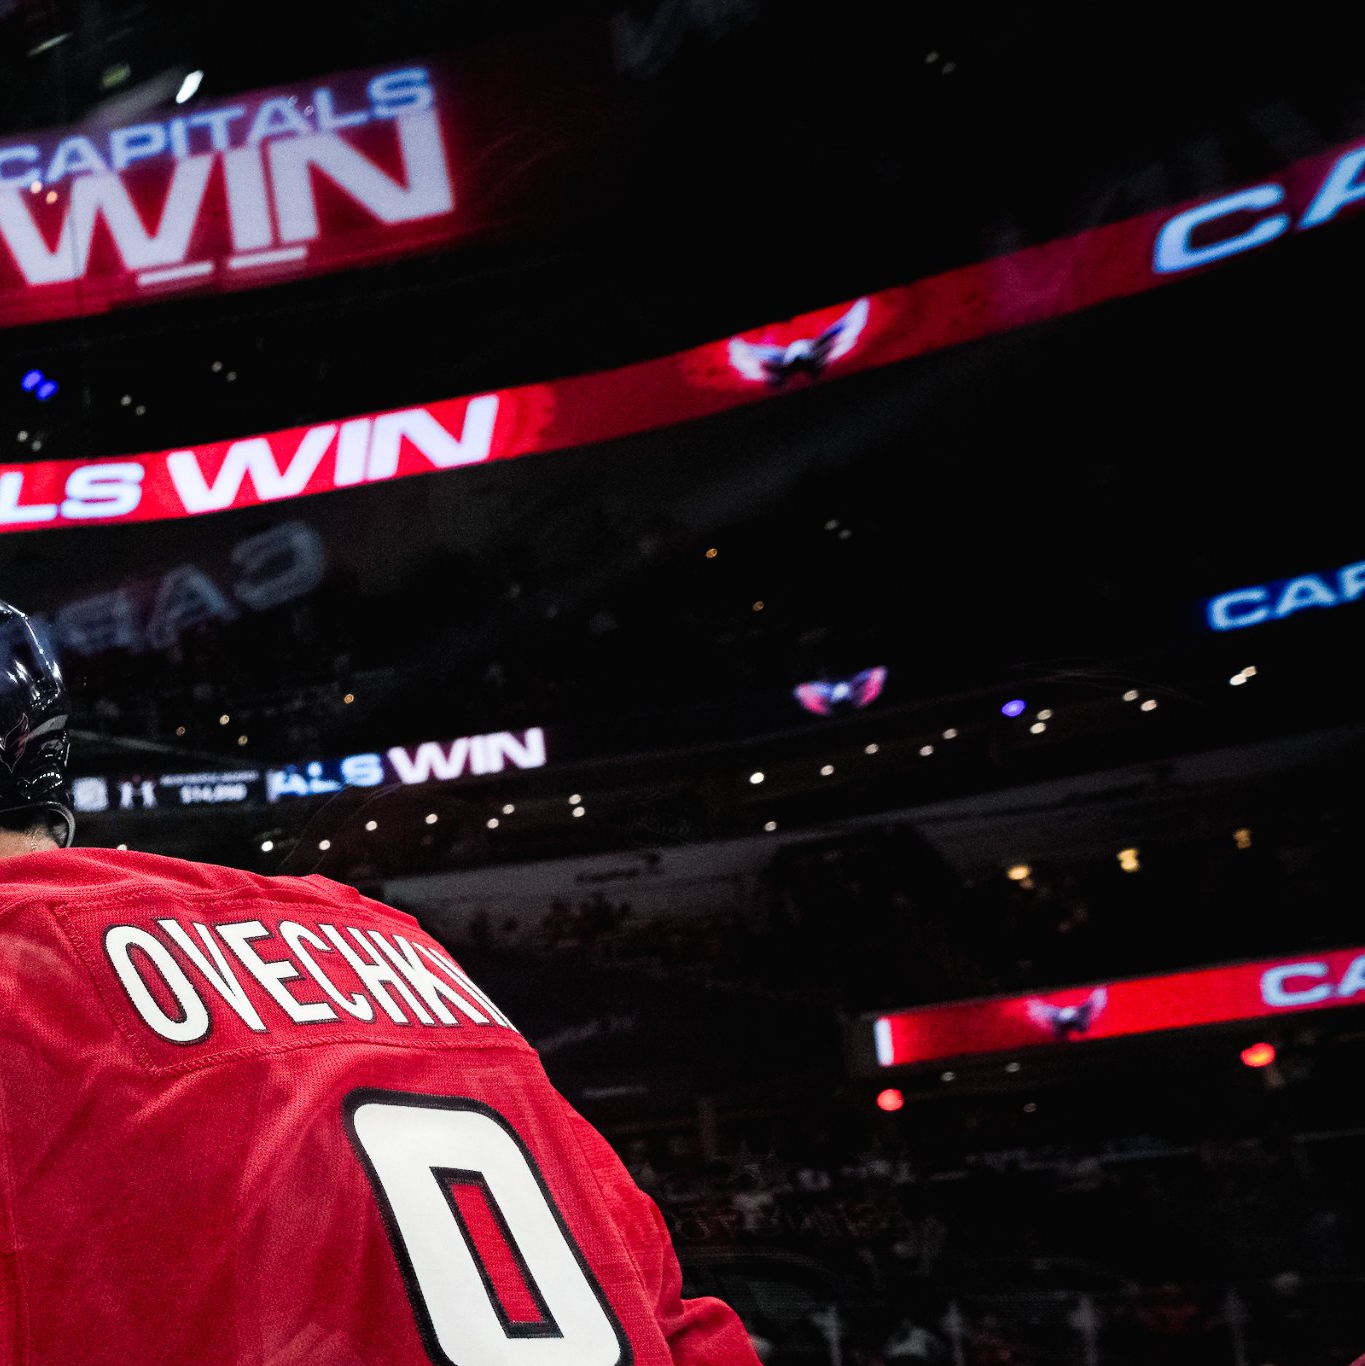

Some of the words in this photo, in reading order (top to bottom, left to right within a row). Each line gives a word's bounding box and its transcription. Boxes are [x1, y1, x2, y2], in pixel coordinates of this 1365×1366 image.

[166, 394, 500, 515] WIN
[387, 727, 547, 785] WIN
[102, 916, 521, 1046] OVECHKI
